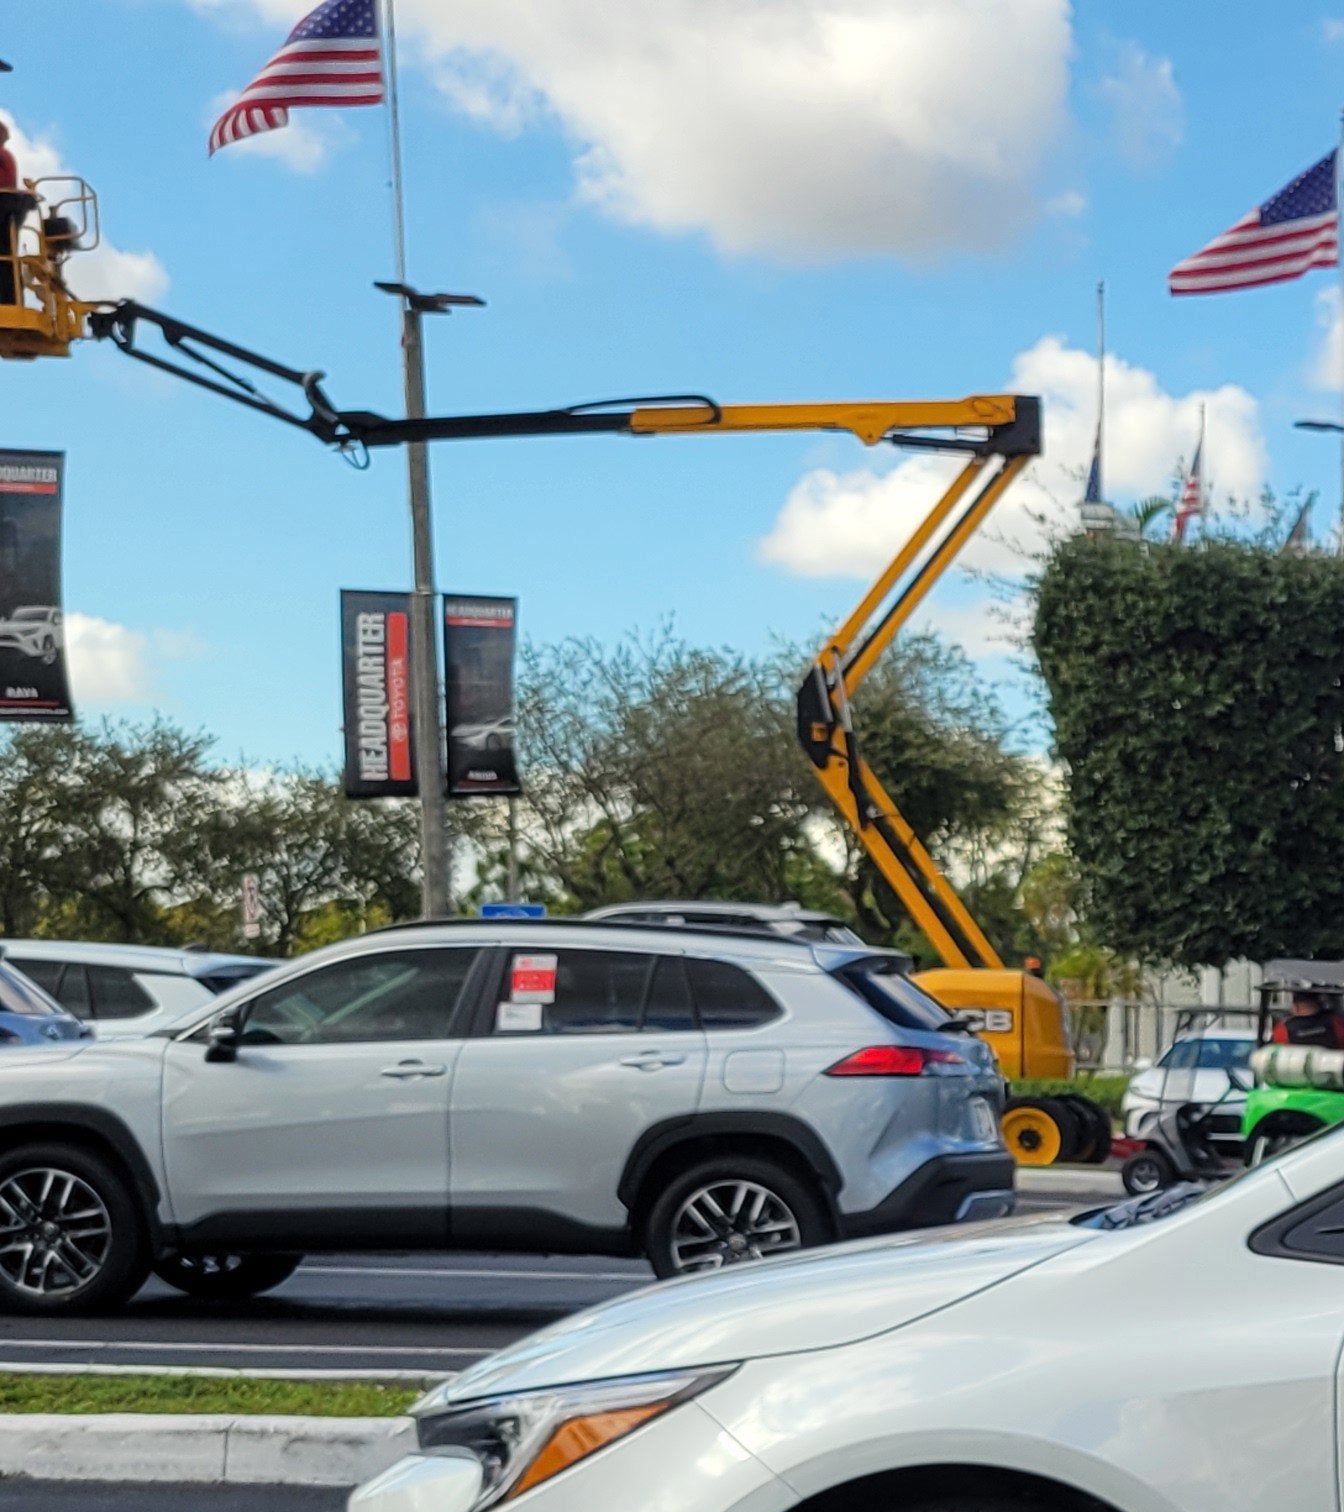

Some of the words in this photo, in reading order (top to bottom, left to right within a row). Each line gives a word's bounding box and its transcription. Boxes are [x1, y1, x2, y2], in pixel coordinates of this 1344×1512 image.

[357, 612, 389, 782] HEADQUARTER
[391, 657, 405, 720] TOYOTA
[948, 1009, 1013, 1031] CB
